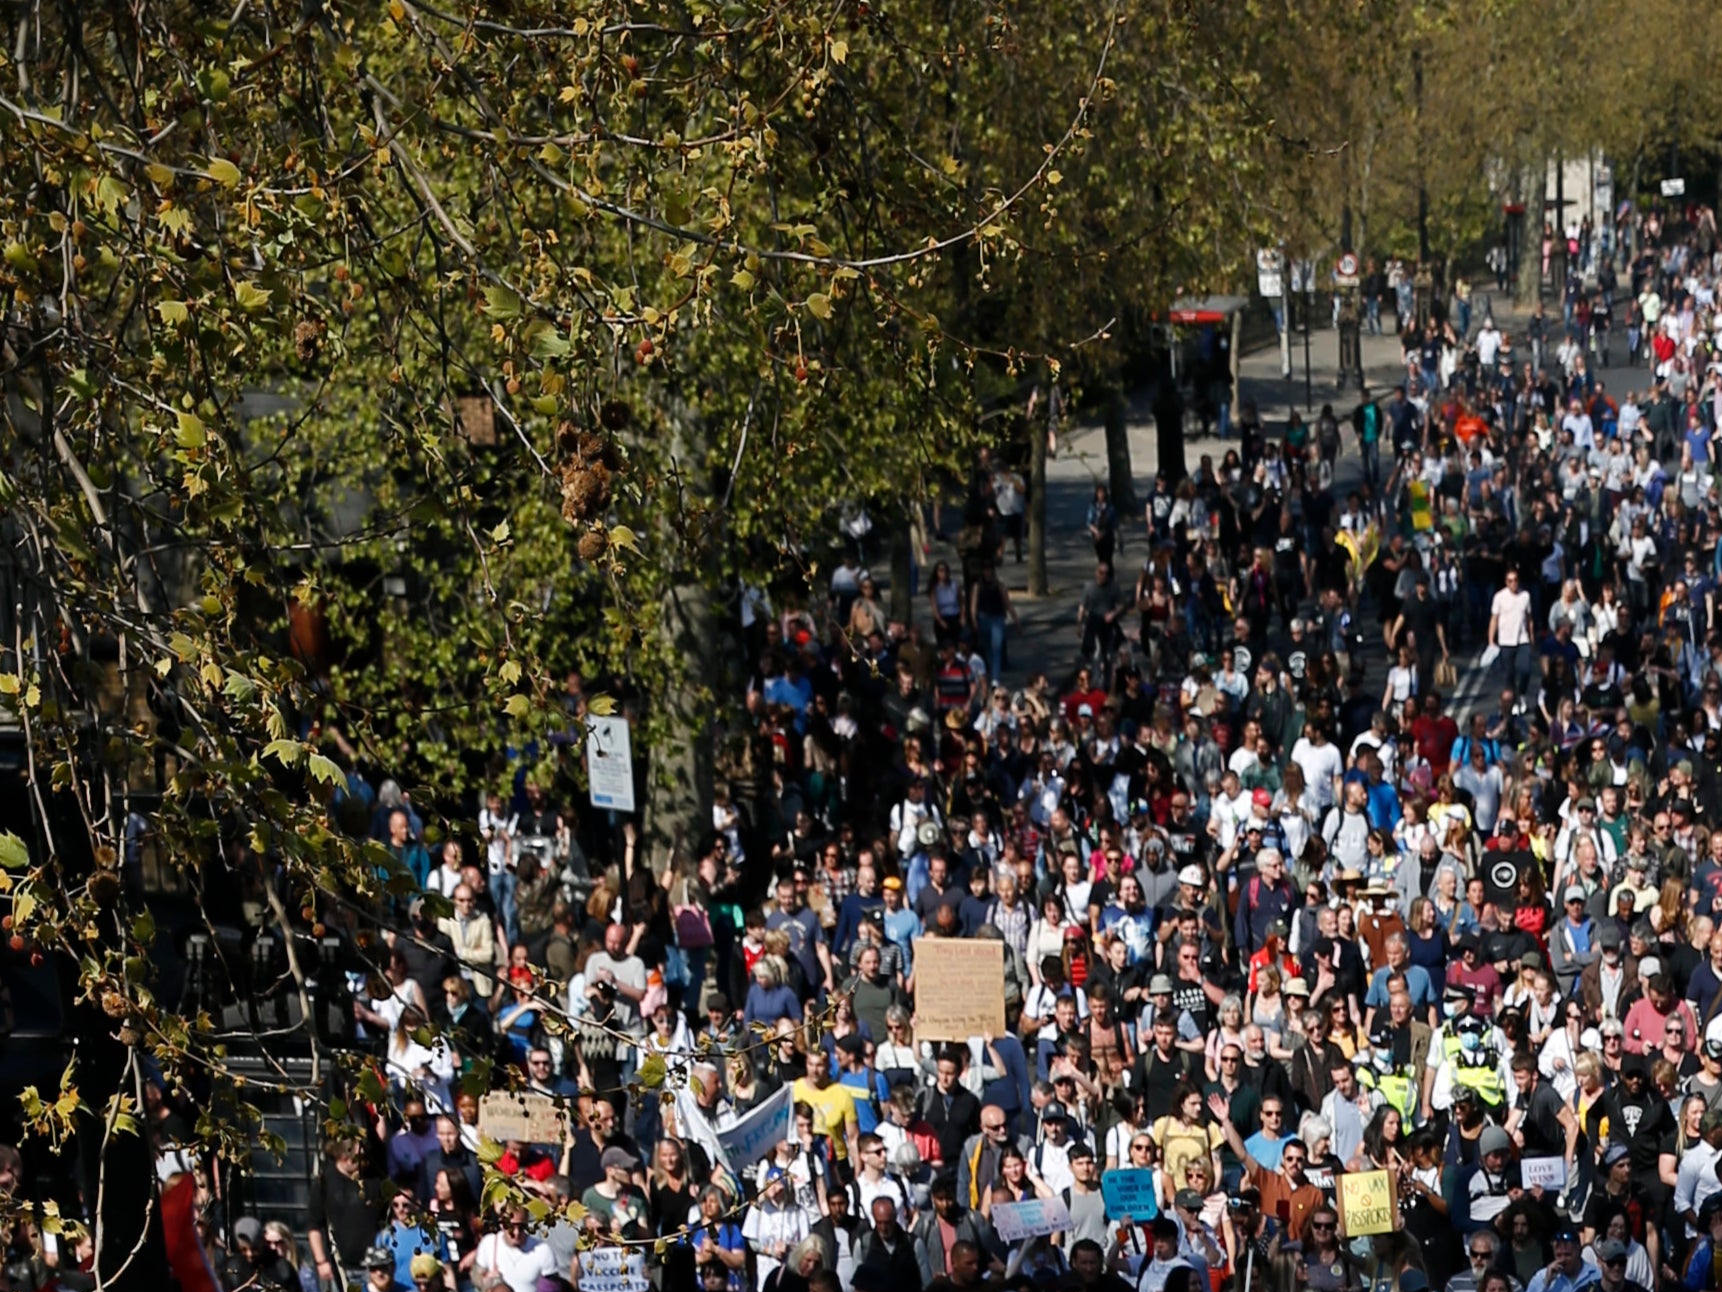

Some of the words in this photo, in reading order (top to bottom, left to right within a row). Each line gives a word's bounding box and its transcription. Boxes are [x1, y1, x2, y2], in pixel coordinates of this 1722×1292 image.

[1528, 1165, 1553, 1173] LOVE
[1529, 1174, 1555, 1183] WINS
[1368, 1177, 1386, 1193] VAX
[592, 1252, 609, 1260] NO
[581, 1281, 647, 1292] PASSPORTS
